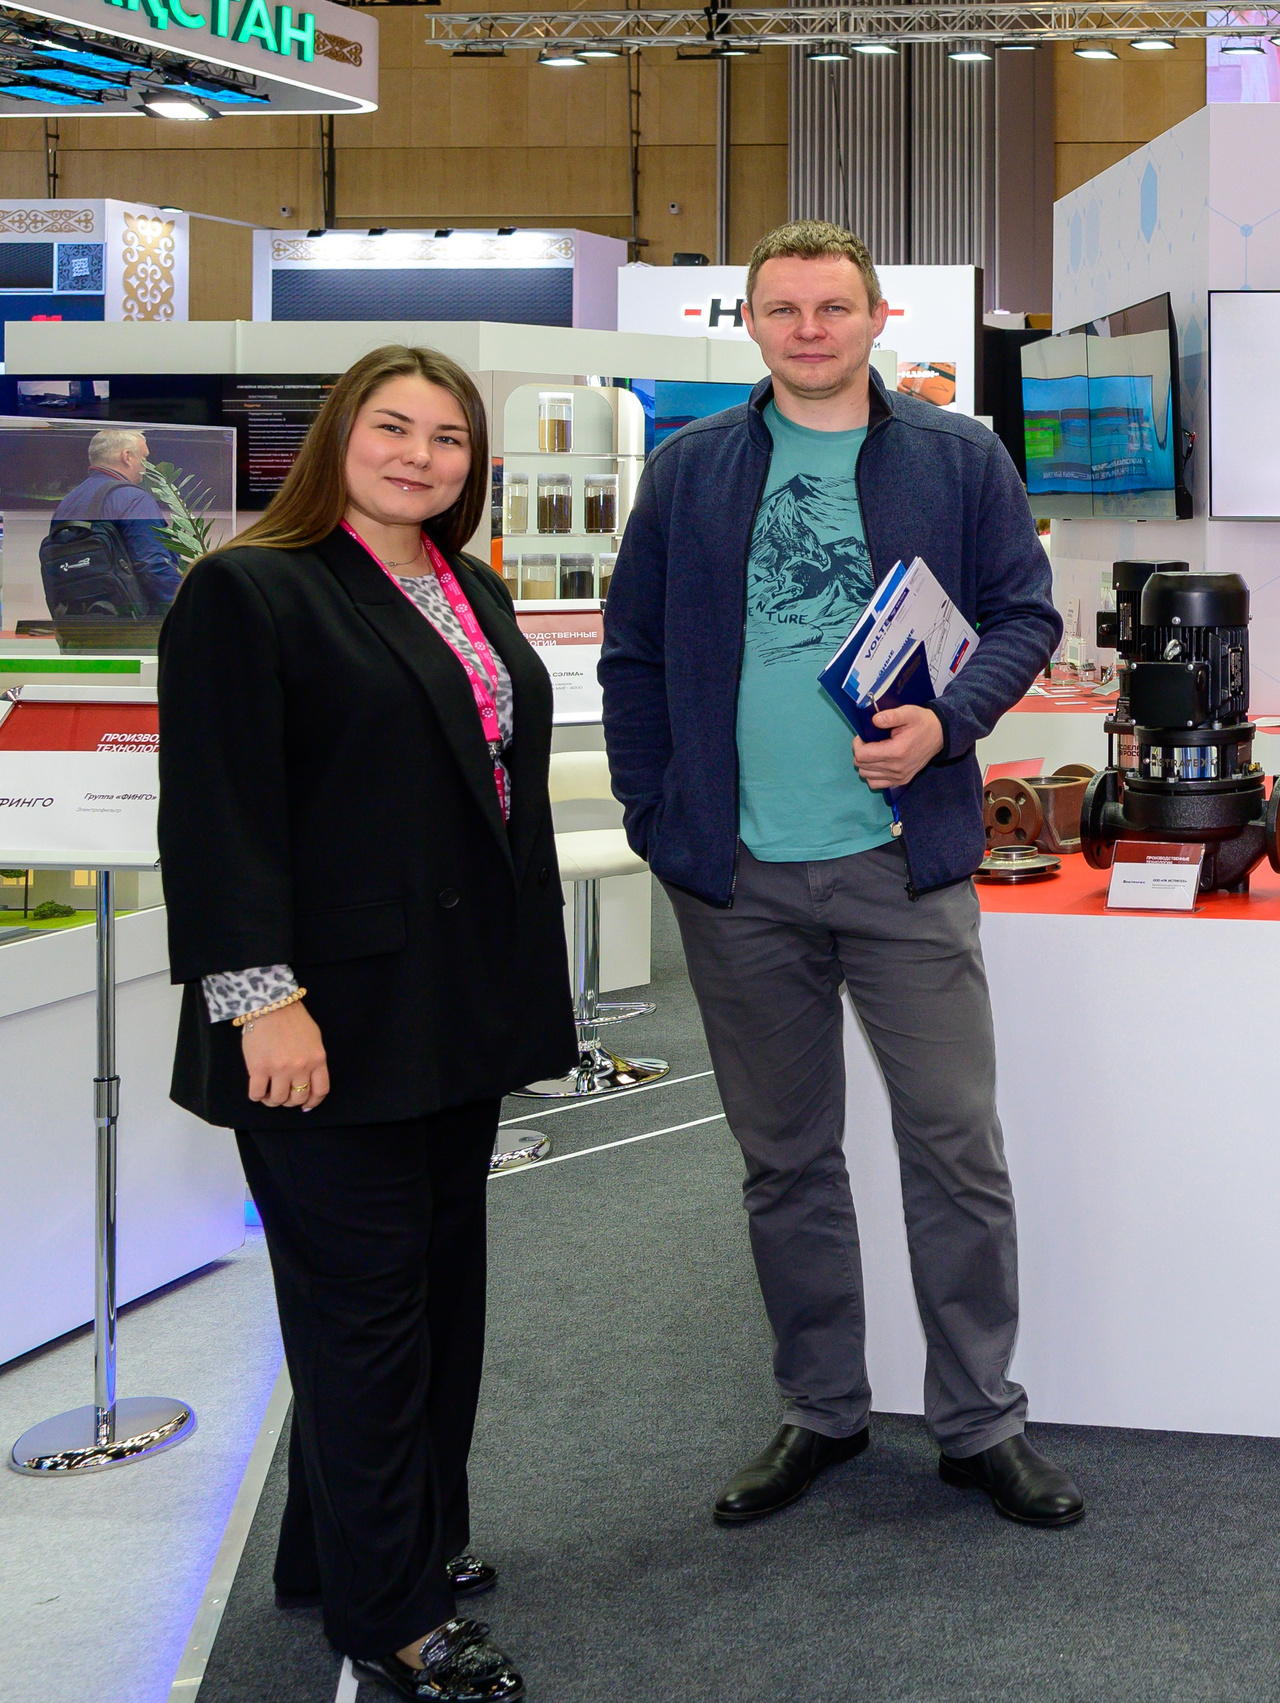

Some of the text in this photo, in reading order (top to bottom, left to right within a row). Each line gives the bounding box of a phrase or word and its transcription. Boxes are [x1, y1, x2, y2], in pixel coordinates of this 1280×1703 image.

[524, 631, 598, 640] ВОДСТВЕННЫЕ
[100, 733, 160, 743] ПРОИЗВО
[84, 792, 157, 801] Группа «ФИНГО»
